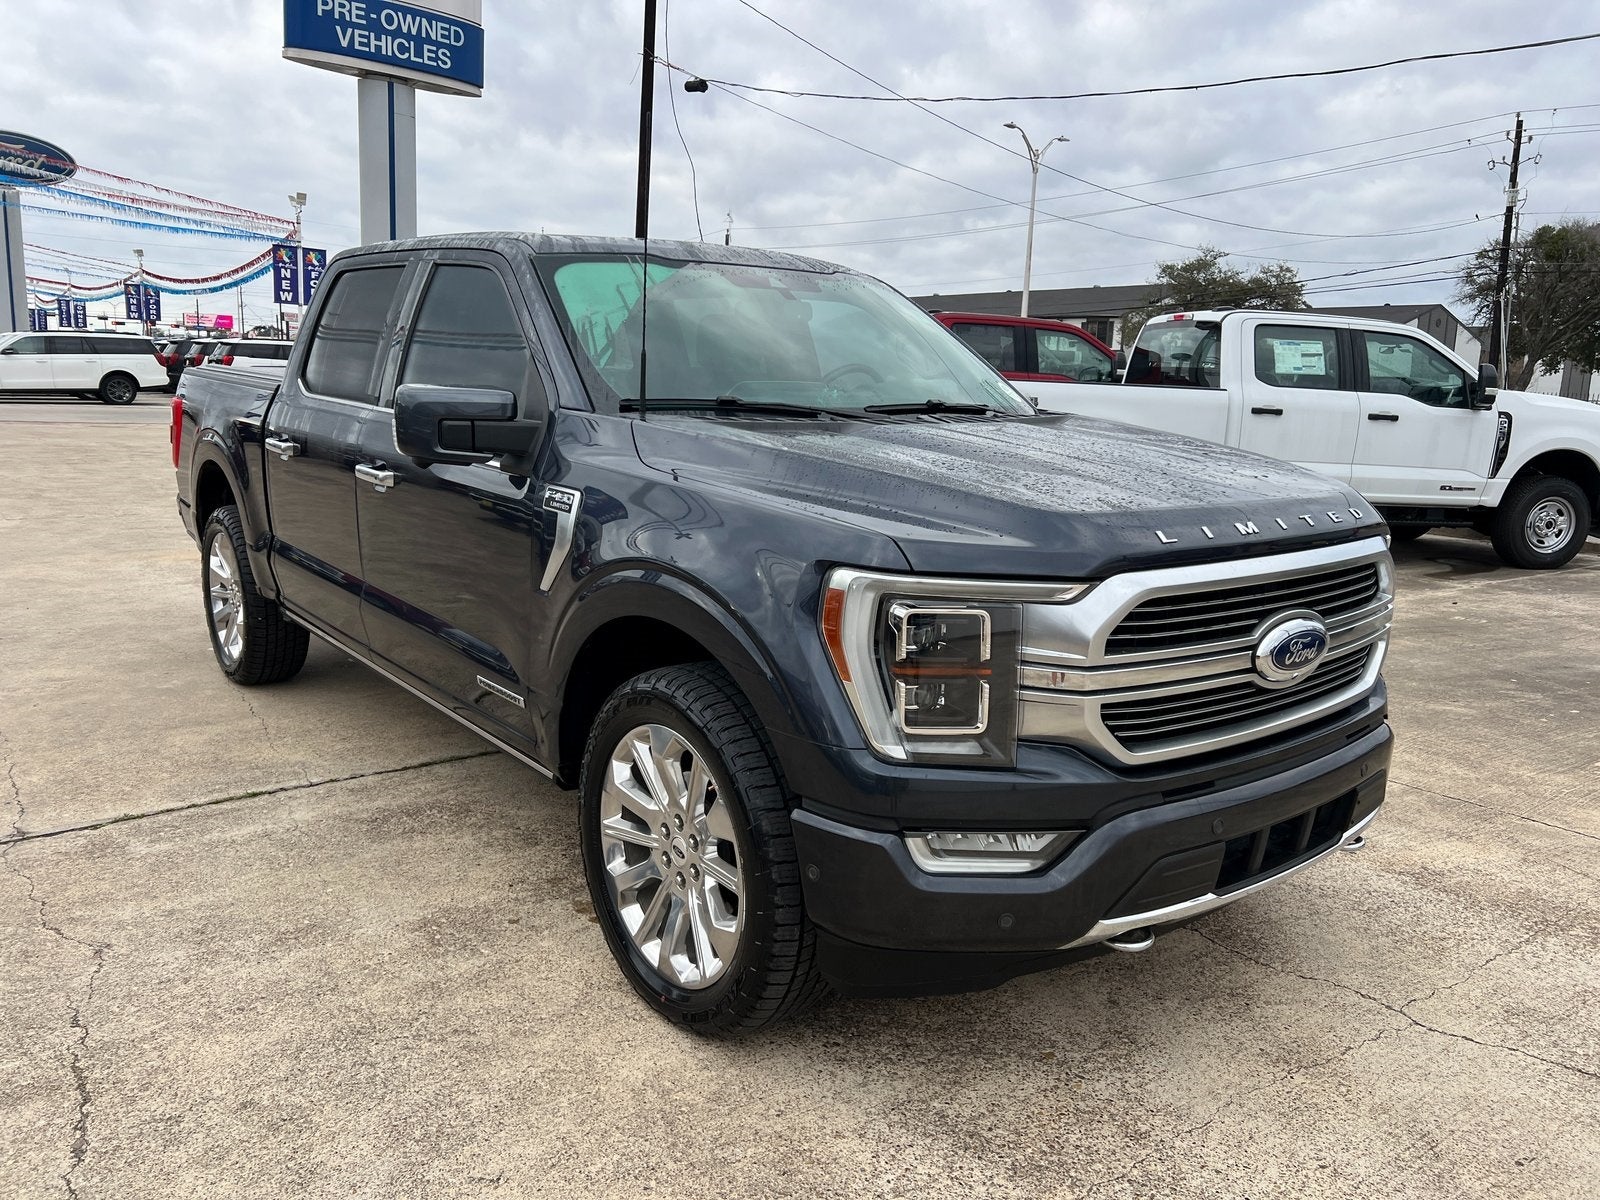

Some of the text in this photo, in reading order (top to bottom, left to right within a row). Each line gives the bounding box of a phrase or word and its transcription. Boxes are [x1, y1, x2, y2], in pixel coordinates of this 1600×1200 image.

[316, 0, 465, 47] PRE-OWNED
[335, 25, 452, 69] VEHICLES
[280, 268, 293, 302] NEW
[130, 297, 139, 319] NEW
[149, 299, 157, 320] FORD
[1155, 507, 1364, 544] LIMITED
[1285, 636, 1319, 665] Ford
